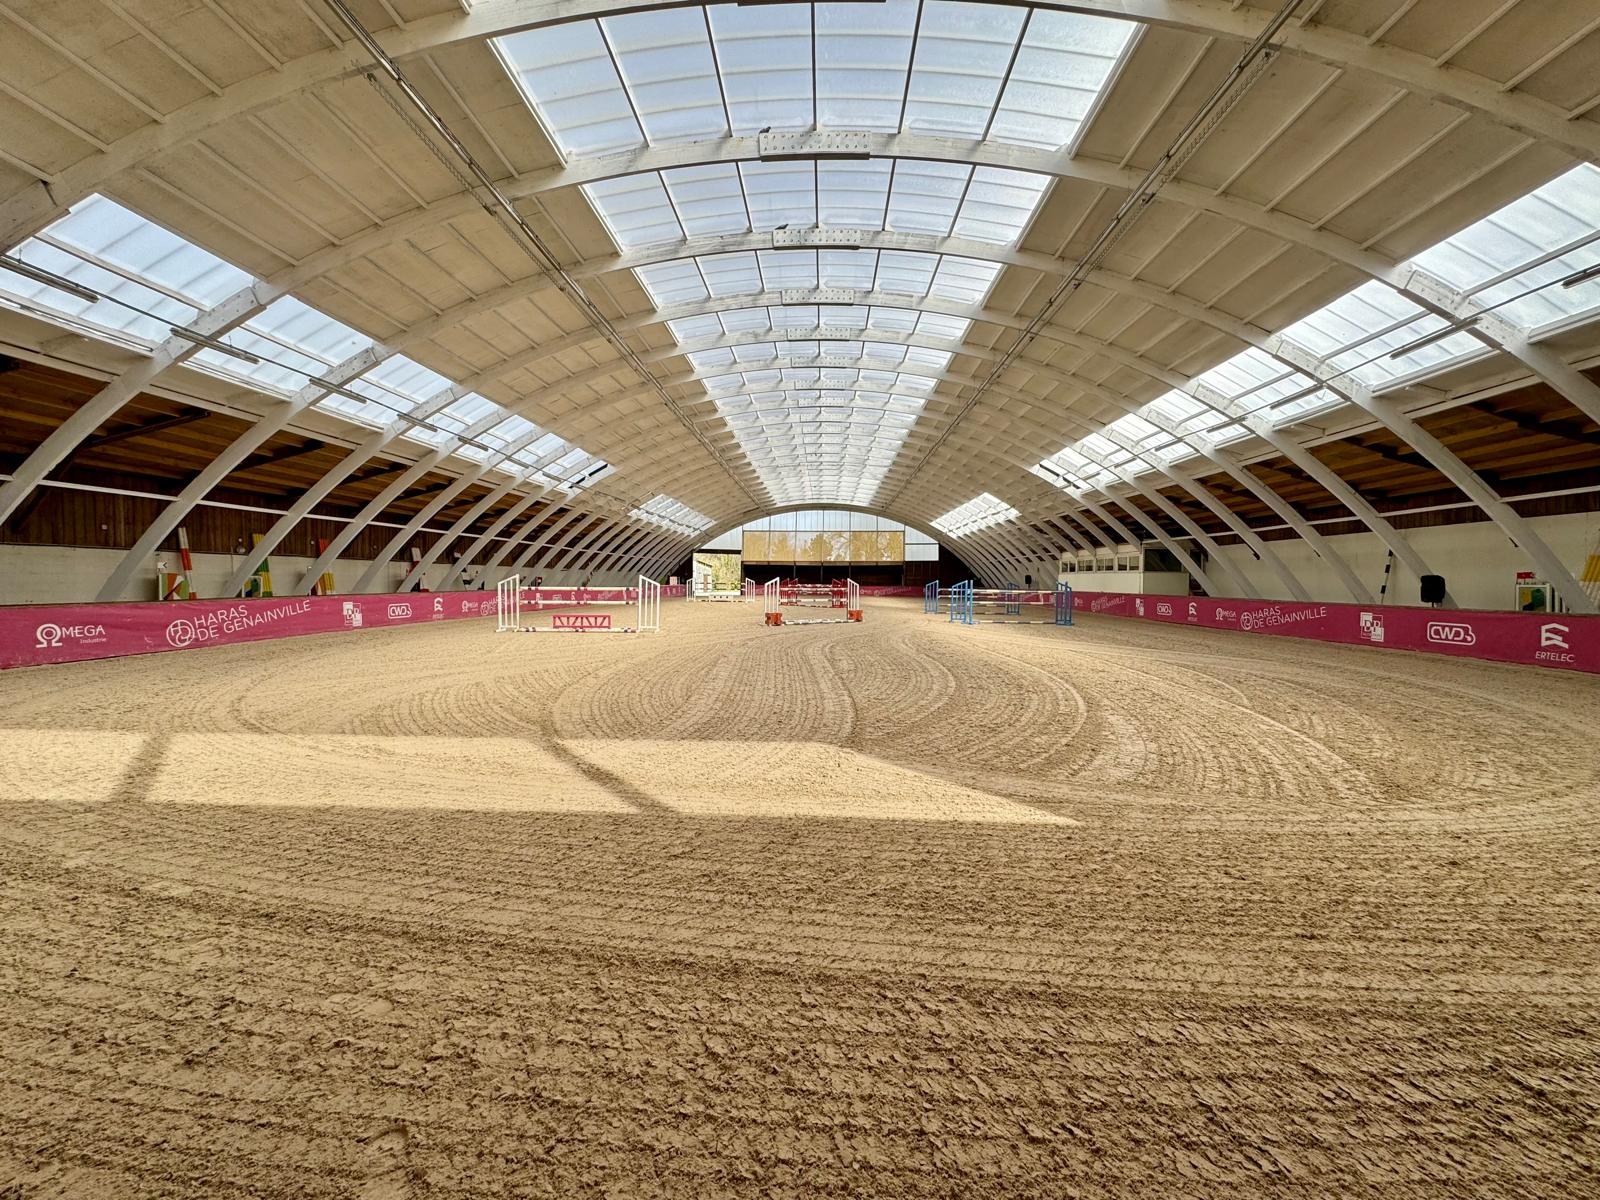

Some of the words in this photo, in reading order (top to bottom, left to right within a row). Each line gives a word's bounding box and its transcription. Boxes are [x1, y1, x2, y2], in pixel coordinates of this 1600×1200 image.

[193, 604, 248, 629] HARAS
[197, 624, 220, 641] DE
[223, 599, 312, 634] GENAINVILLE
[1252, 605, 1281, 620] HARAS
[1253, 618, 1264, 629] DE
[1266, 606, 1327, 627] GENAINVILLE
[1430, 625, 1465, 641] CWD
[1535, 650, 1576, 663] ERTELEC
